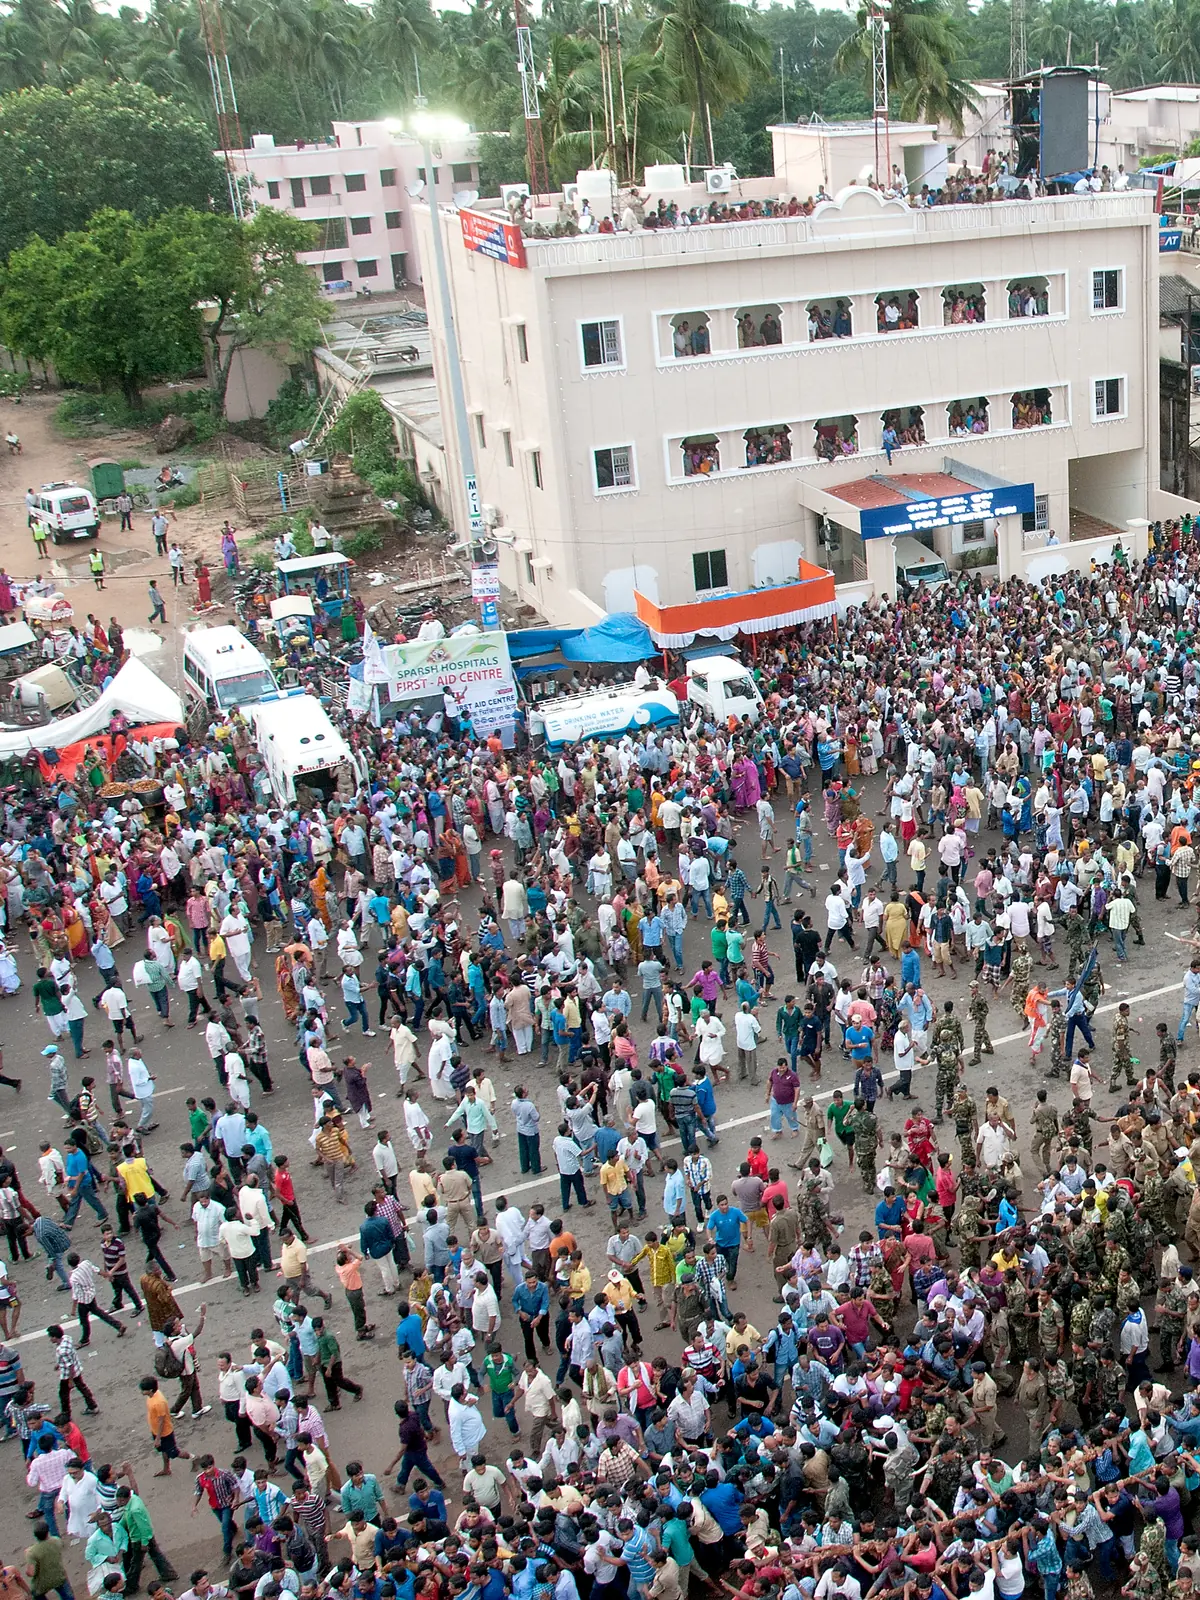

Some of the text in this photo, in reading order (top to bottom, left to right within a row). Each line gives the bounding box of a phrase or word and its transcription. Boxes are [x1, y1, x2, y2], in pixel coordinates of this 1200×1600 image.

[915, 517, 949, 530] POLICE
[397, 665, 439, 679] SPARSH
[441, 656, 499, 672] HOSPITALS
[396, 679, 427, 692] FIRST
[437, 674, 457, 686] AID
[460, 668, 503, 682] CENTRE
[456, 703, 472, 711] IRST
[488, 695, 516, 706] CENTRE
[564, 713, 597, 725] DRINKING
[600, 707, 625, 717] WATER
[293, 760, 342, 774] AMBULANC
